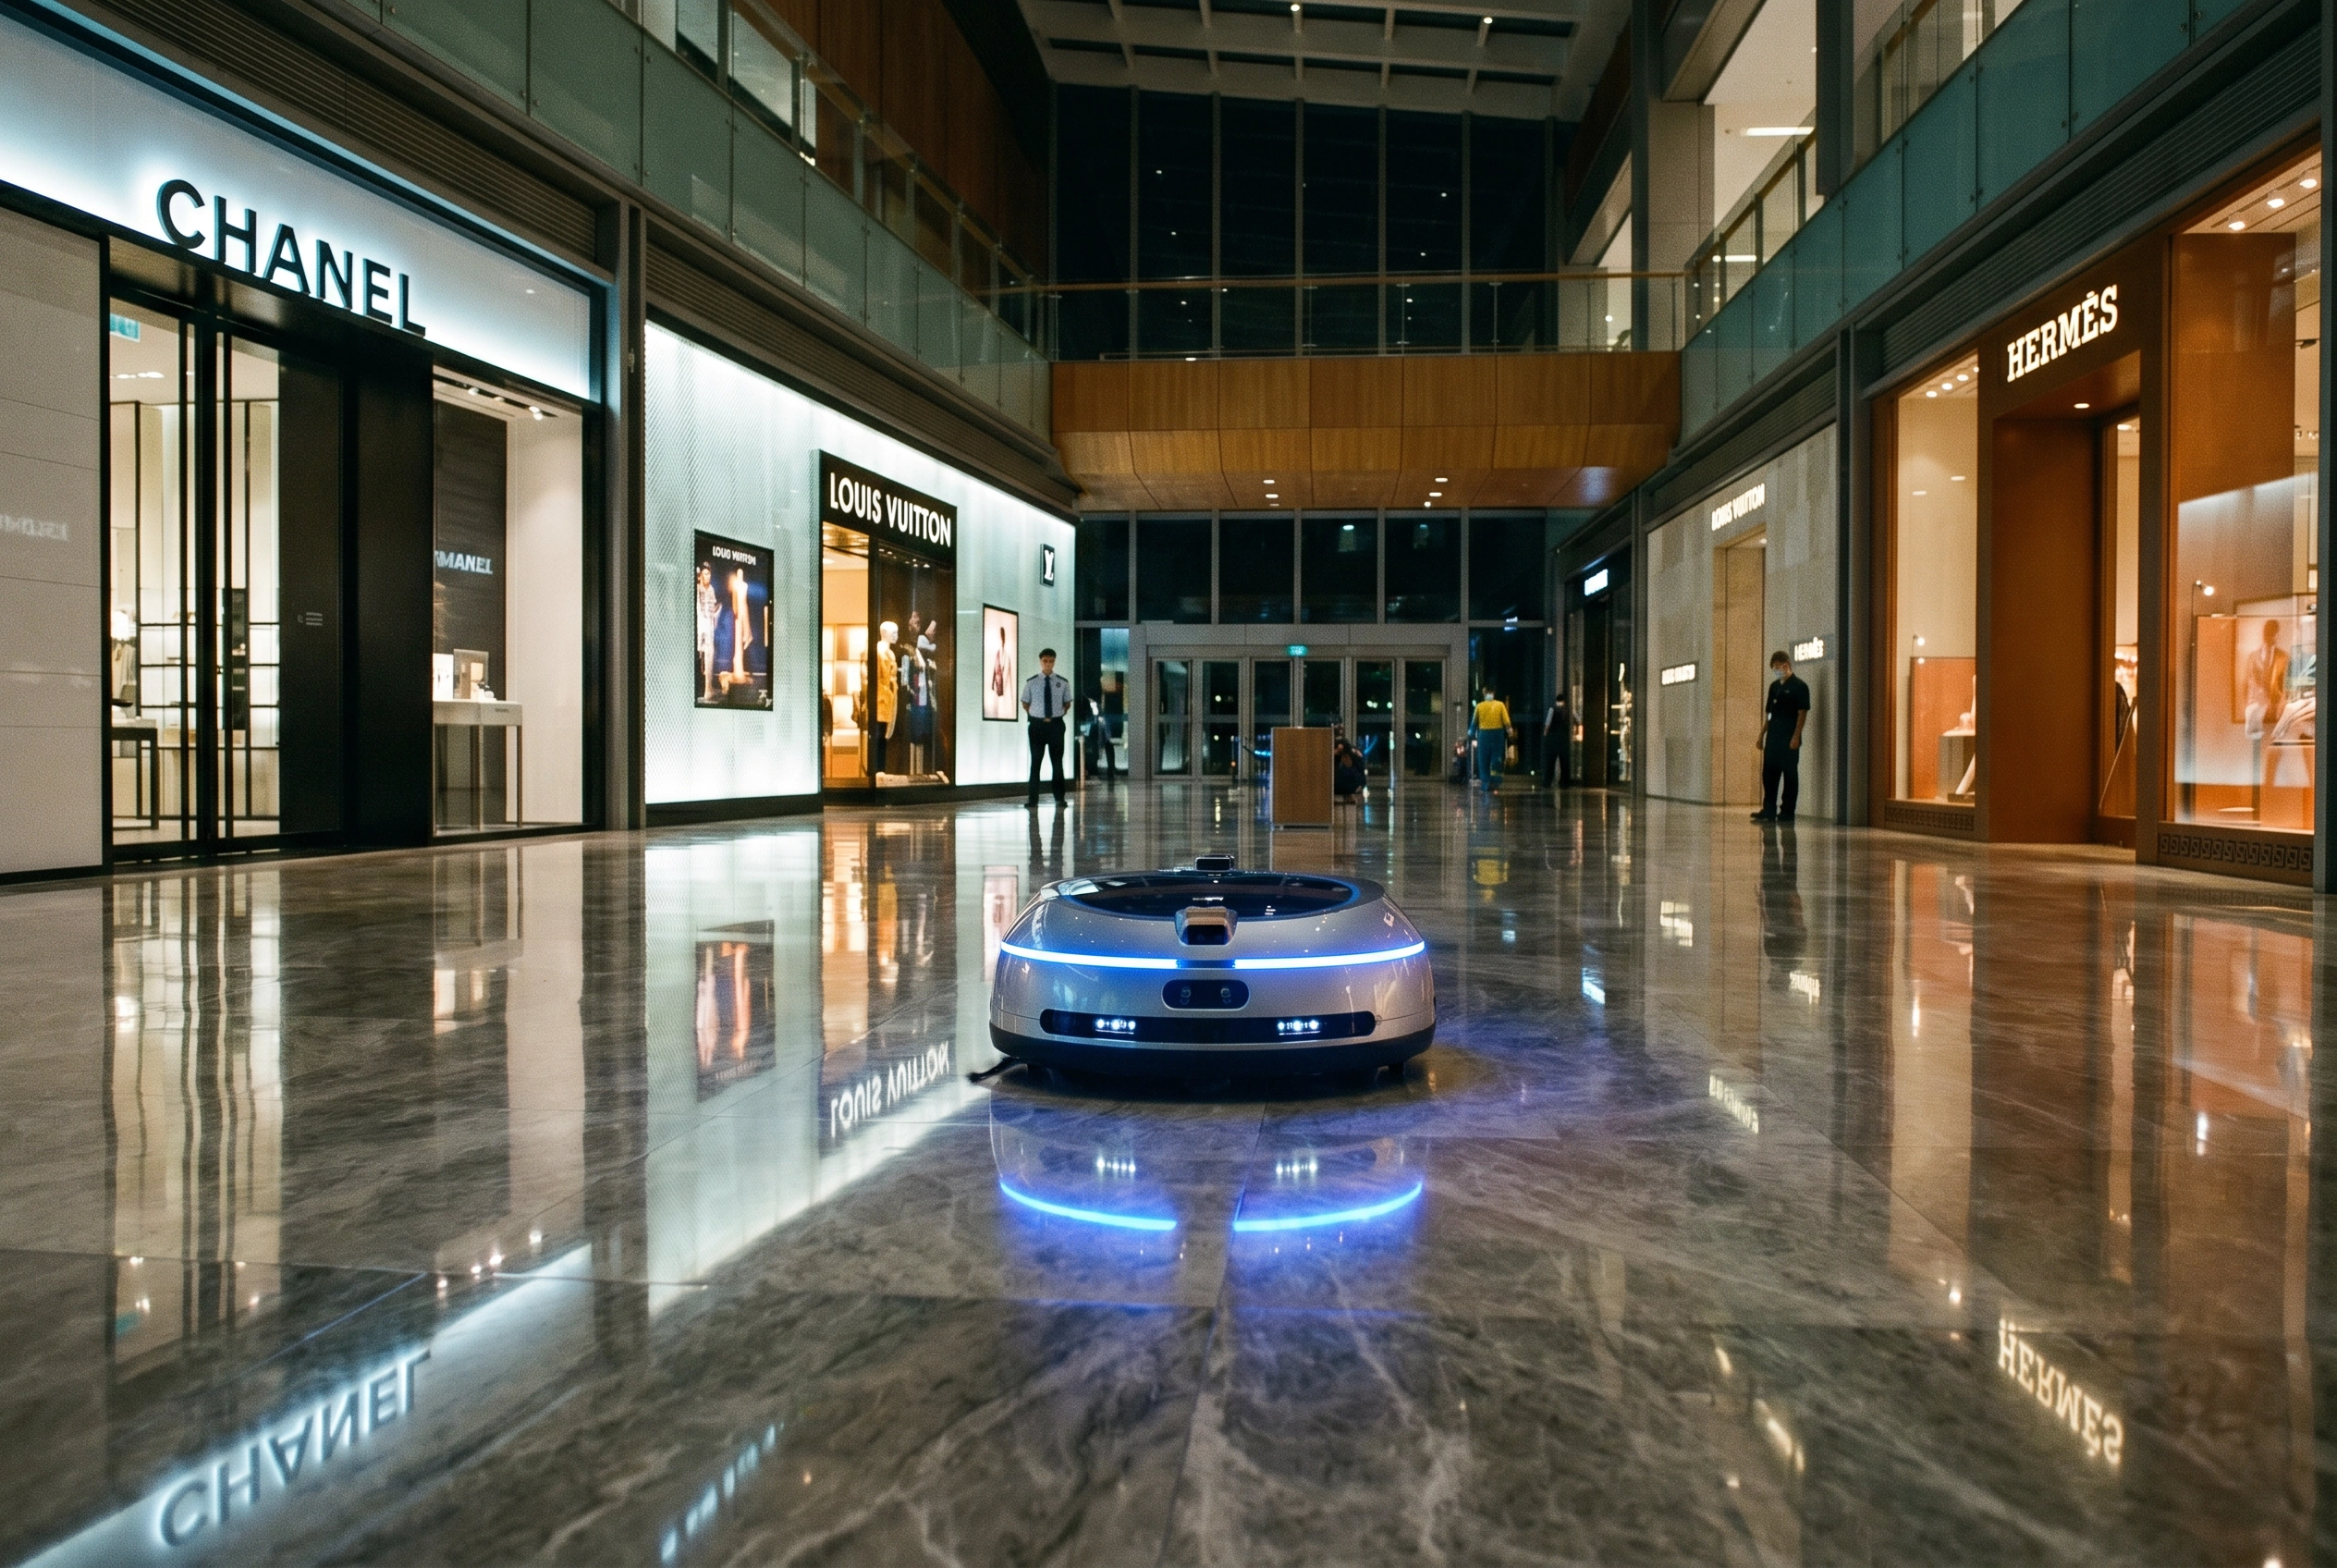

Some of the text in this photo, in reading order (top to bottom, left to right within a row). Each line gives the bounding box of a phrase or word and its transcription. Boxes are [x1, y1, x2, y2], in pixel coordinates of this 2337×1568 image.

[156, 178, 427, 337] CHANEL
[829, 472, 951, 547] LOUIS VUITTON
